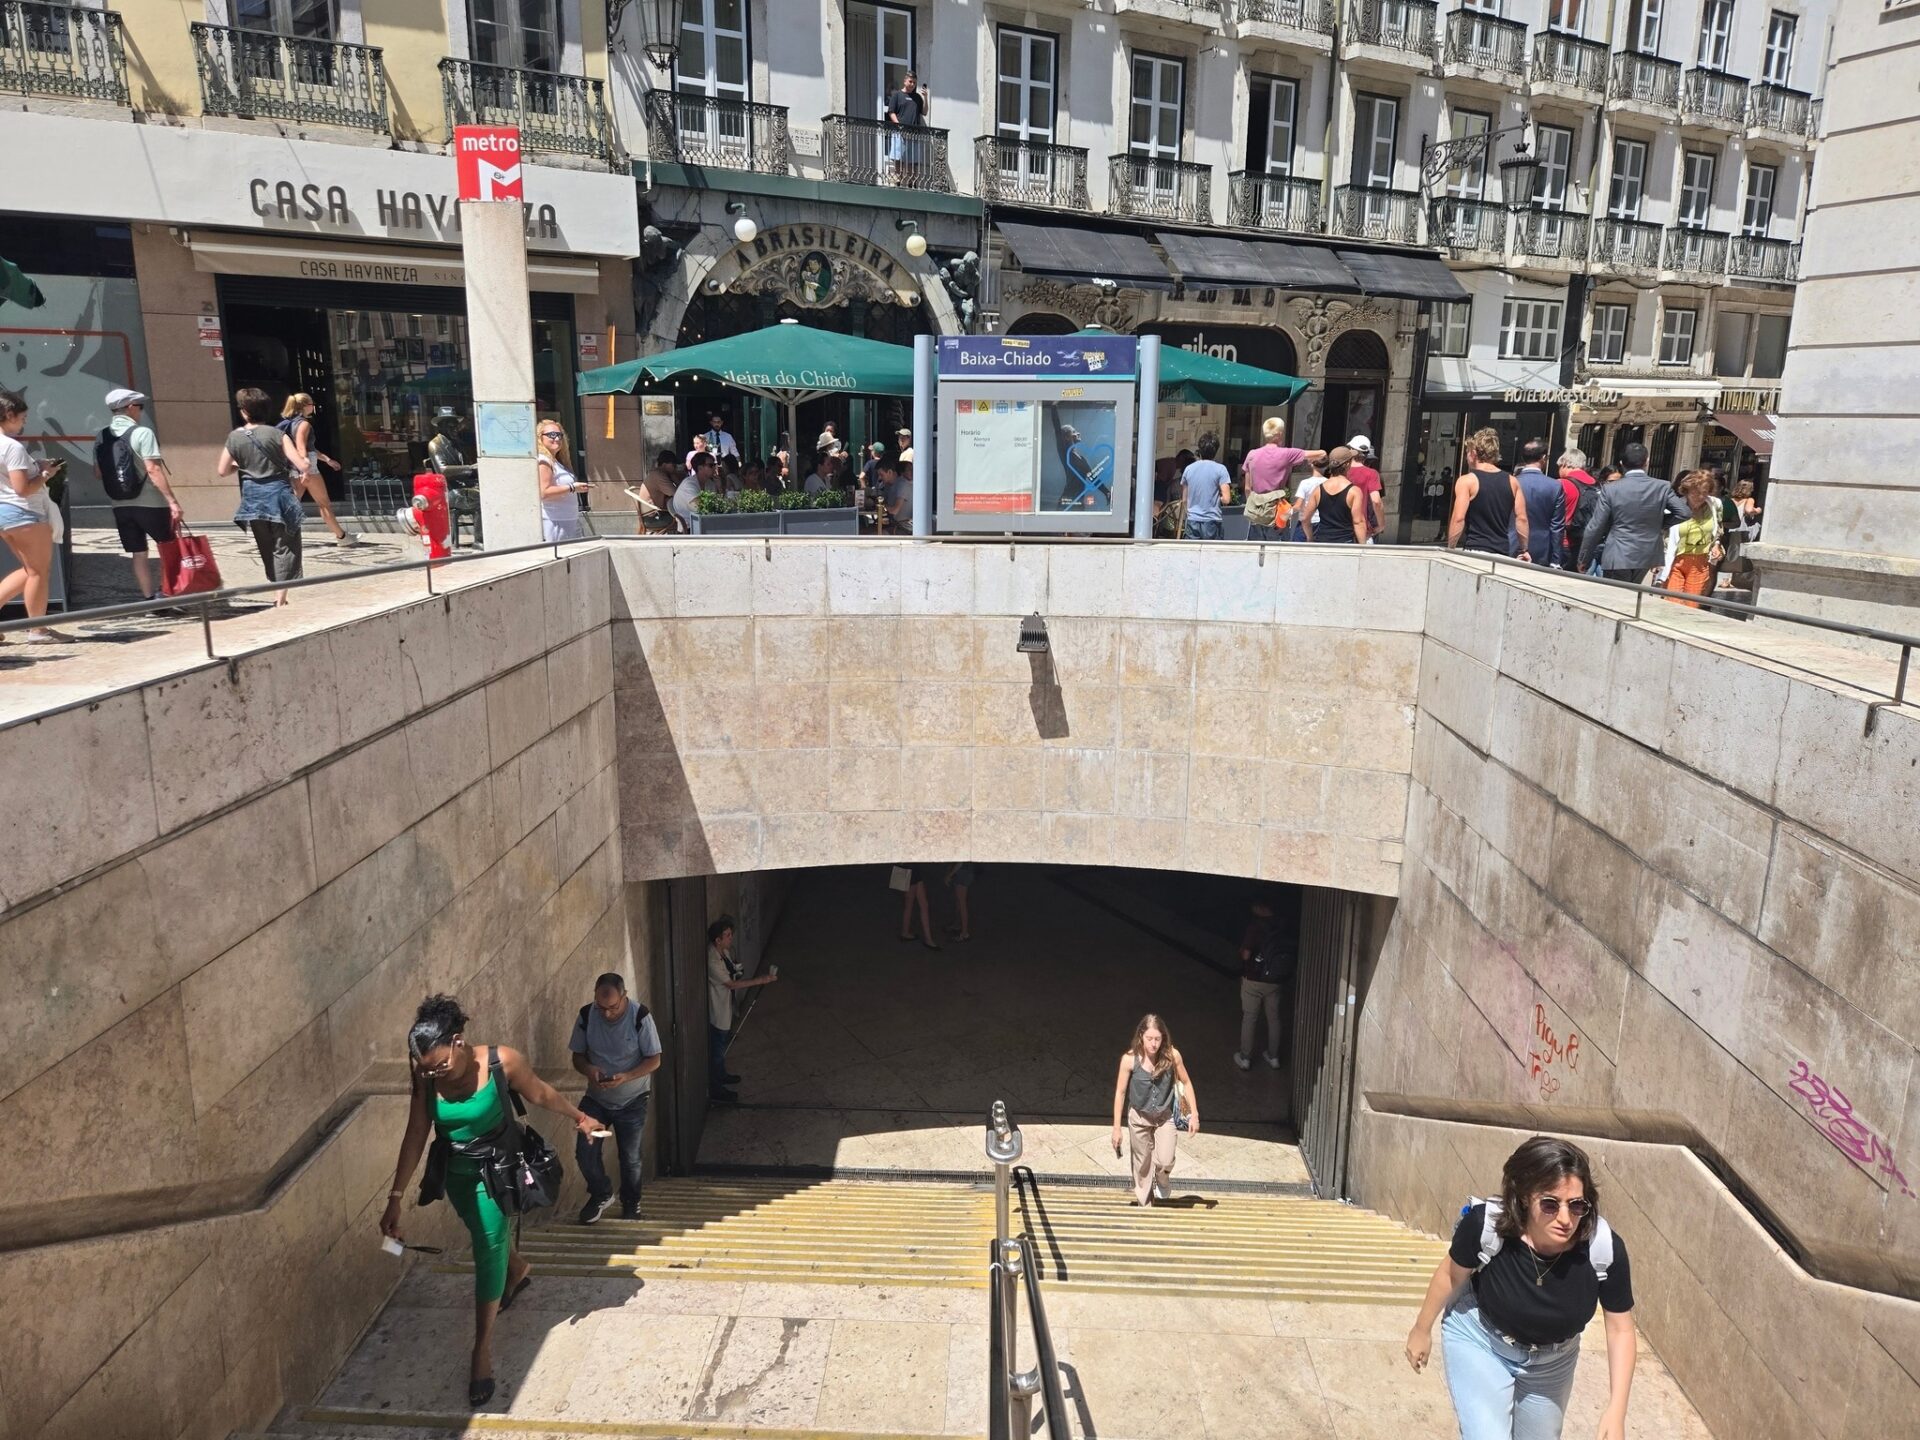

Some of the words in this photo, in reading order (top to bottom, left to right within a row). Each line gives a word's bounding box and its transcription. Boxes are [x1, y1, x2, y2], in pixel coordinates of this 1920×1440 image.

[462, 134, 518, 152] metro
[250, 178, 350, 224] CASA
[736, 249, 750, 268] A
[752, 226, 895, 280] BRASILEIRA
[300, 260, 337, 278] CASA
[344, 263, 419, 283] HAVANEZA
[960, 351, 1052, 366] Baixa-Chiado
[775, 370, 797, 385] do
[800, 370, 857, 389] Chiado
[1503, 388, 1539, 403] HOTEL
[1539, 388, 1579, 403] BORGES
[1580, 389, 1618, 403] CHIADO
